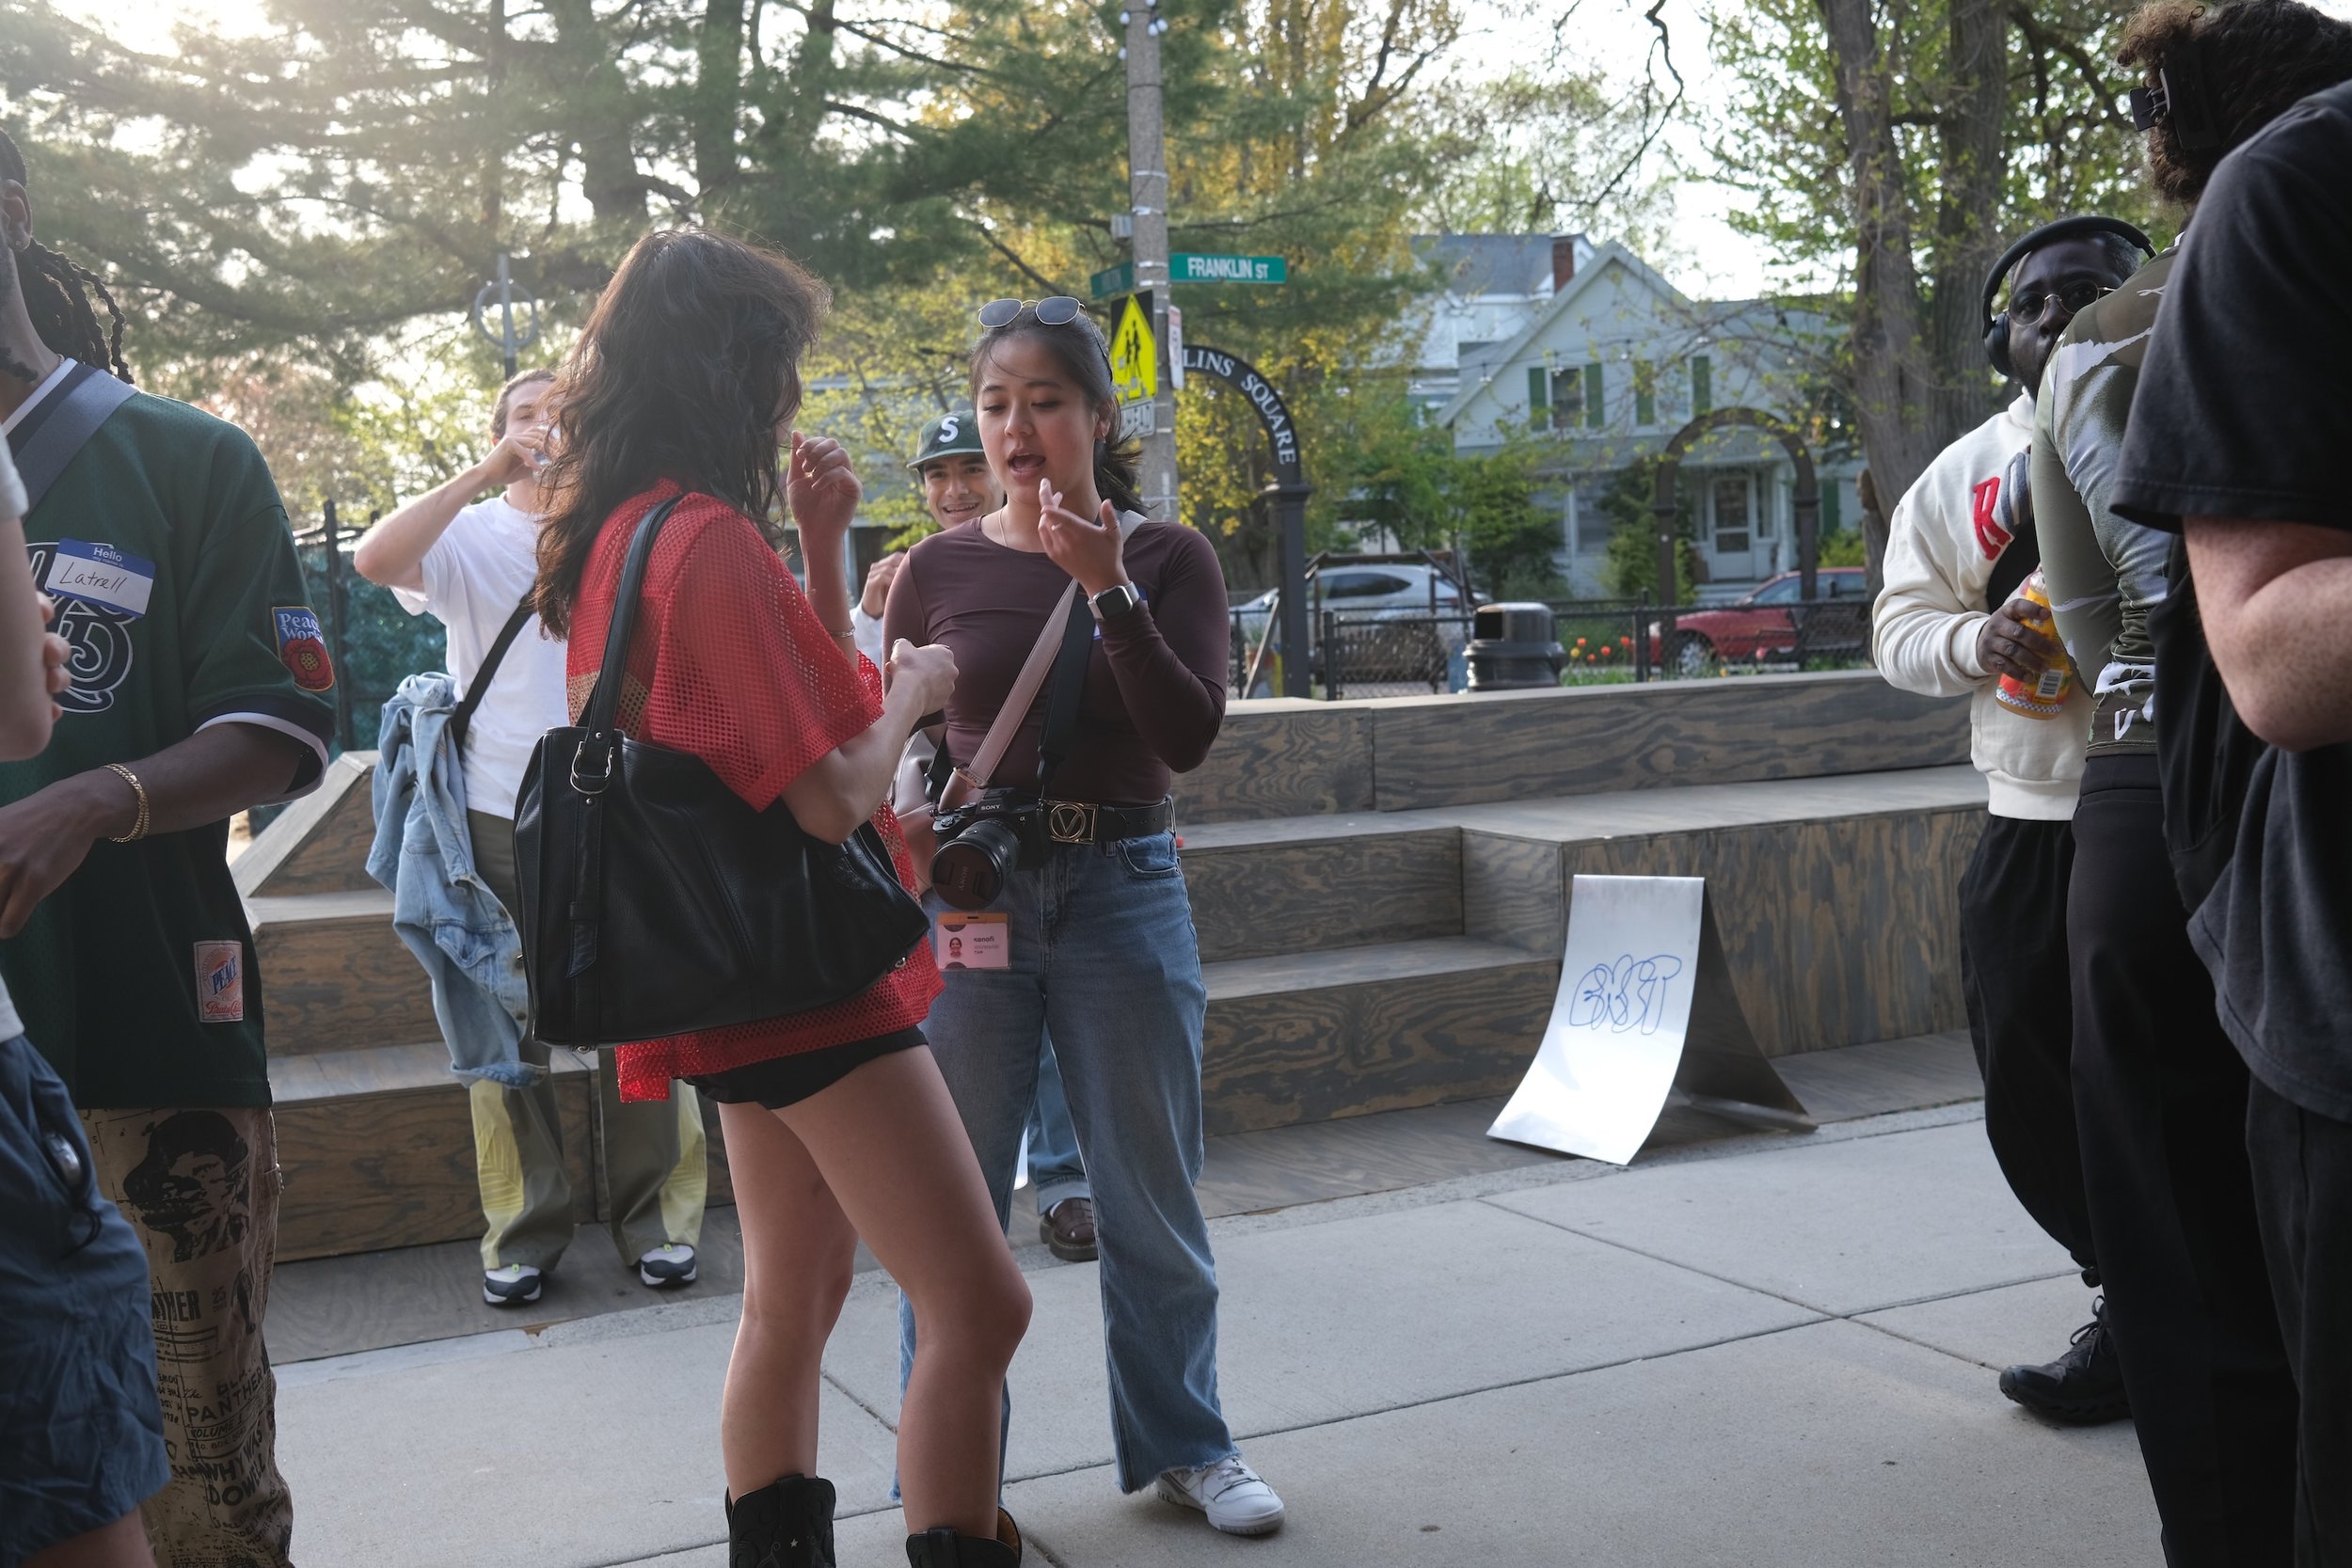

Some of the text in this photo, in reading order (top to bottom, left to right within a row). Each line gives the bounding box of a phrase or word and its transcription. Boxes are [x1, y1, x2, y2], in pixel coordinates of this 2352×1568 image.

[1187, 257, 1269, 279] FRANKLIN ST
[1184, 350, 1296, 466] LINS SQUARE
[938, 416, 960, 443] S
[93, 546, 122, 562] Hello
[59, 562, 128, 594] Latrell
[151, 1290, 201, 1323] THER
[186, 1367, 264, 1423] PANTHER
[190, 1418, 235, 1439] VOLUME
[205, 1455, 245, 1482] WHY
[208, 1452, 267, 1507] DOWELL
